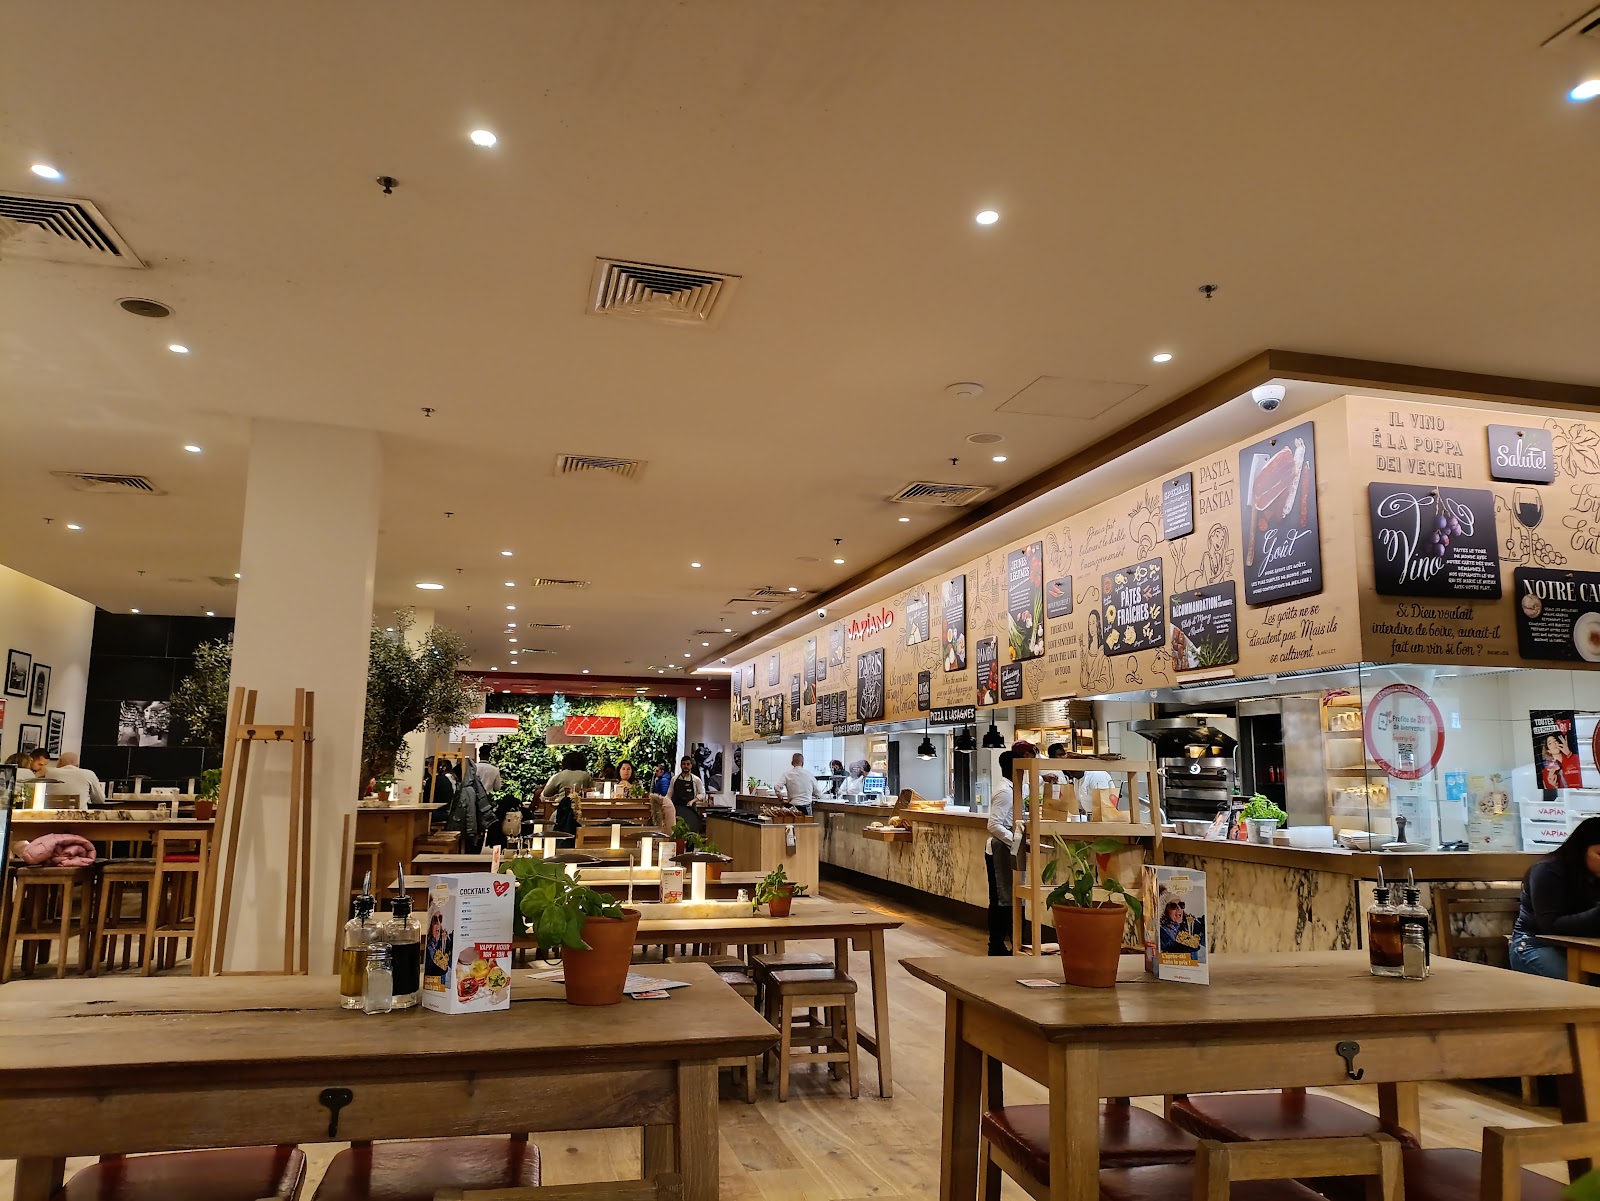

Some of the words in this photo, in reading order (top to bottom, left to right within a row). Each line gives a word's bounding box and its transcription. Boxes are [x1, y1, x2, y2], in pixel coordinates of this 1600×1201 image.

[1389, 412, 1404, 427] IL
[1409, 413, 1445, 431] VINO
[1387, 433, 1407, 450] LA
[1413, 436, 1463, 456] POPPA
[1496, 438, 1547, 470] Salute!
[1199, 459, 1230, 484] PASTA
[1376, 455, 1401, 473] DEI
[1407, 458, 1463, 479] VECCHI
[1199, 488, 1234, 515] BASTA!
[1258, 528, 1312, 577] Goût
[1010, 556, 1027, 571] JEUNES
[1120, 586, 1142, 608] PÂTES
[1523, 579, 1577, 601] NOTRE
[1579, 583, 1600, 603] CA
[1117, 603, 1150, 626] FRAÎCHES
[1262, 606, 1276, 626] Les
[1277, 607, 1297, 628] goûts
[1299, 607, 1310, 617] ne
[1310, 605, 1320, 615] se
[1397, 602, 1409, 618] Si
[1411, 603, 1437, 619] Dieu
[1437, 606, 1474, 620] voulait
[1050, 623, 1063, 635] THERE
[1063, 622, 1067, 631] IS
[1067, 621, 1073, 630] NO
[1246, 629, 1282, 647] discutent
[1300, 619, 1326, 641] Mais
[1326, 616, 1338, 633] ils
[1372, 622, 1414, 635] interdire
[1415, 623, 1427, 636] de
[1429, 622, 1455, 639] boire,
[1457, 625, 1500, 639] aurait-il
[1048, 653, 1058, 664] THAN
[1058, 651, 1067, 661] THE
[1391, 639, 1409, 657] fait
[1410, 643, 1425, 653] un
[1426, 642, 1443, 655] vin
[1445, 643, 1454, 654] si
[1456, 641, 1475, 656] bon
[1477, 644, 1484, 656] ?
[858, 653, 882, 679] PARIS
[1270, 654, 1278, 663] se
[930, 710, 944, 721] PIZZA
[948, 708, 975, 721] LASAGNES
[1410, 716, 1416, 724] de
[1534, 718, 1554, 726] TOUTES
[1538, 807, 1566, 815] VAPIAN
[460, 887, 490, 896] COCKTAILS
